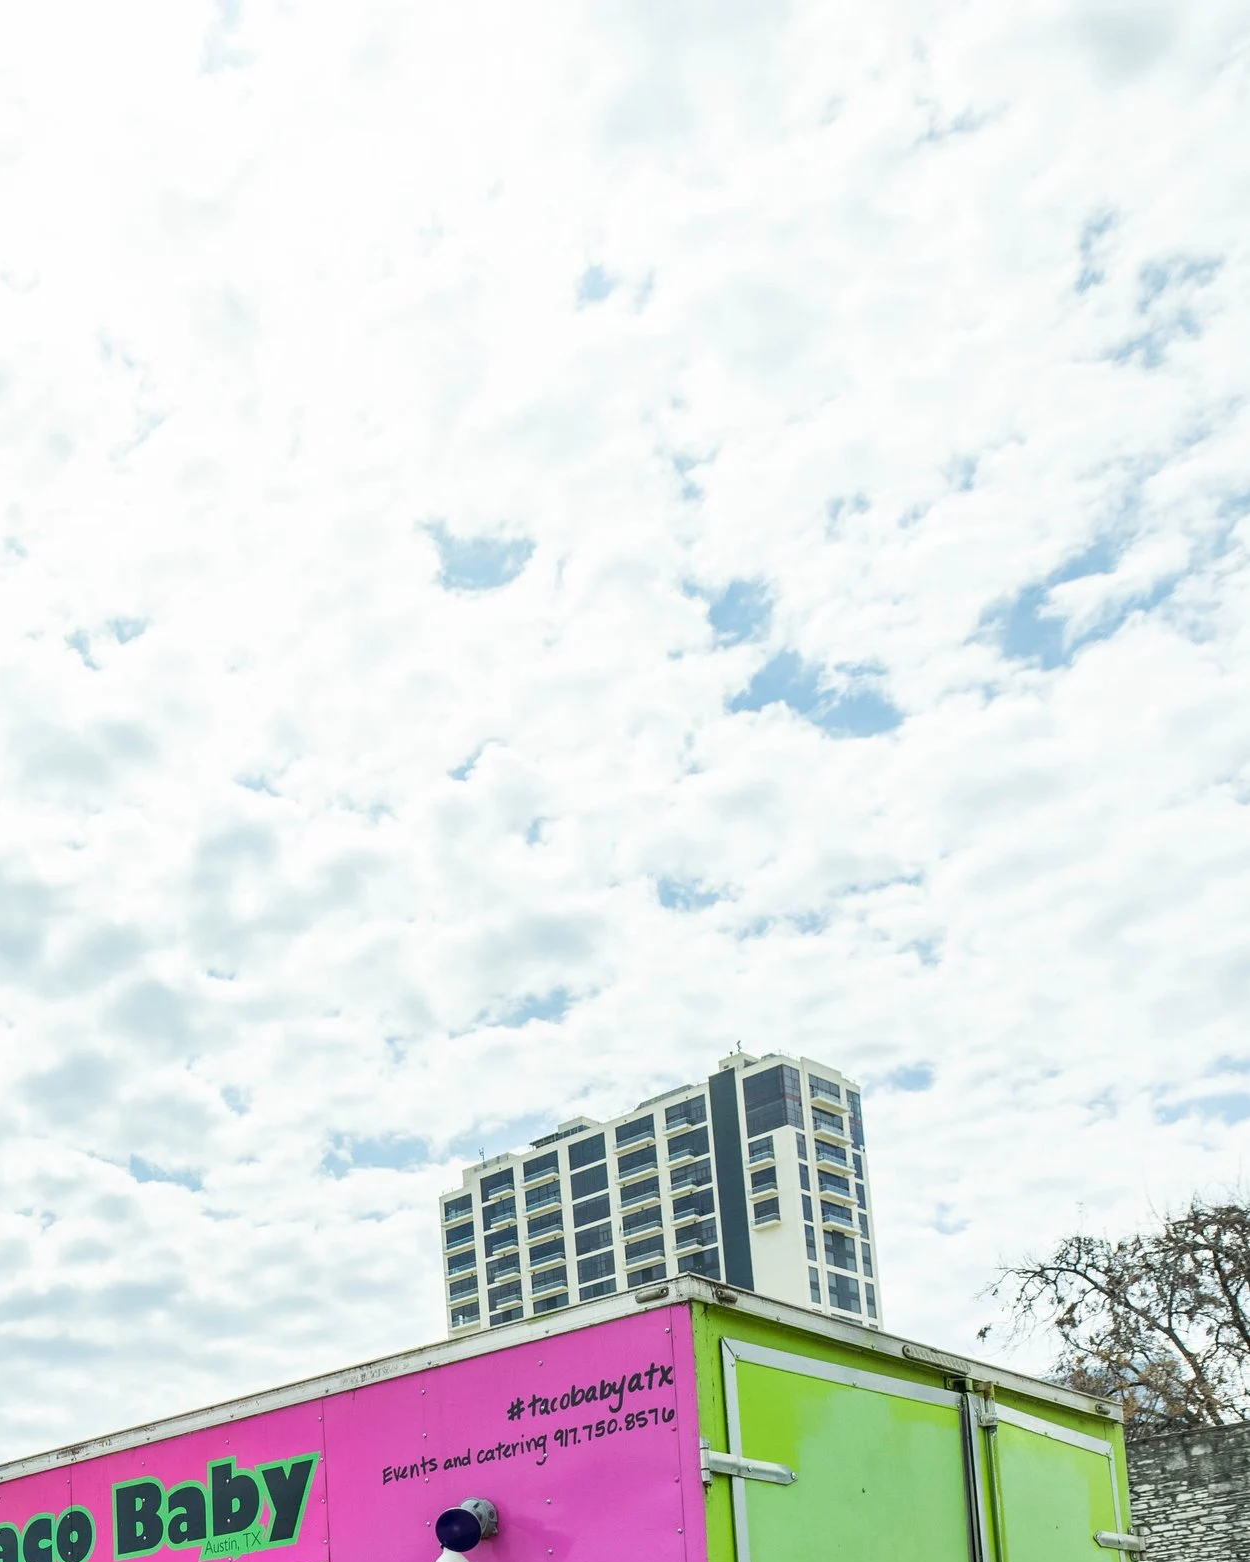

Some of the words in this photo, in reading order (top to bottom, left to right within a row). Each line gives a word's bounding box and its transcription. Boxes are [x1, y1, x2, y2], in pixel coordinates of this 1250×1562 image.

[506, 1362, 675, 1422] #tacobabyatx
[382, 1456, 438, 1486] Events
[442, 1448, 472, 1471] and
[476, 1433, 548, 1467] catering
[553, 1407, 676, 1448] 917.750.8576
[113, 1454, 319, 1559] Baby
[204, 1539, 240, 1557] Austin,
[243, 1530, 262, 1547] TX
